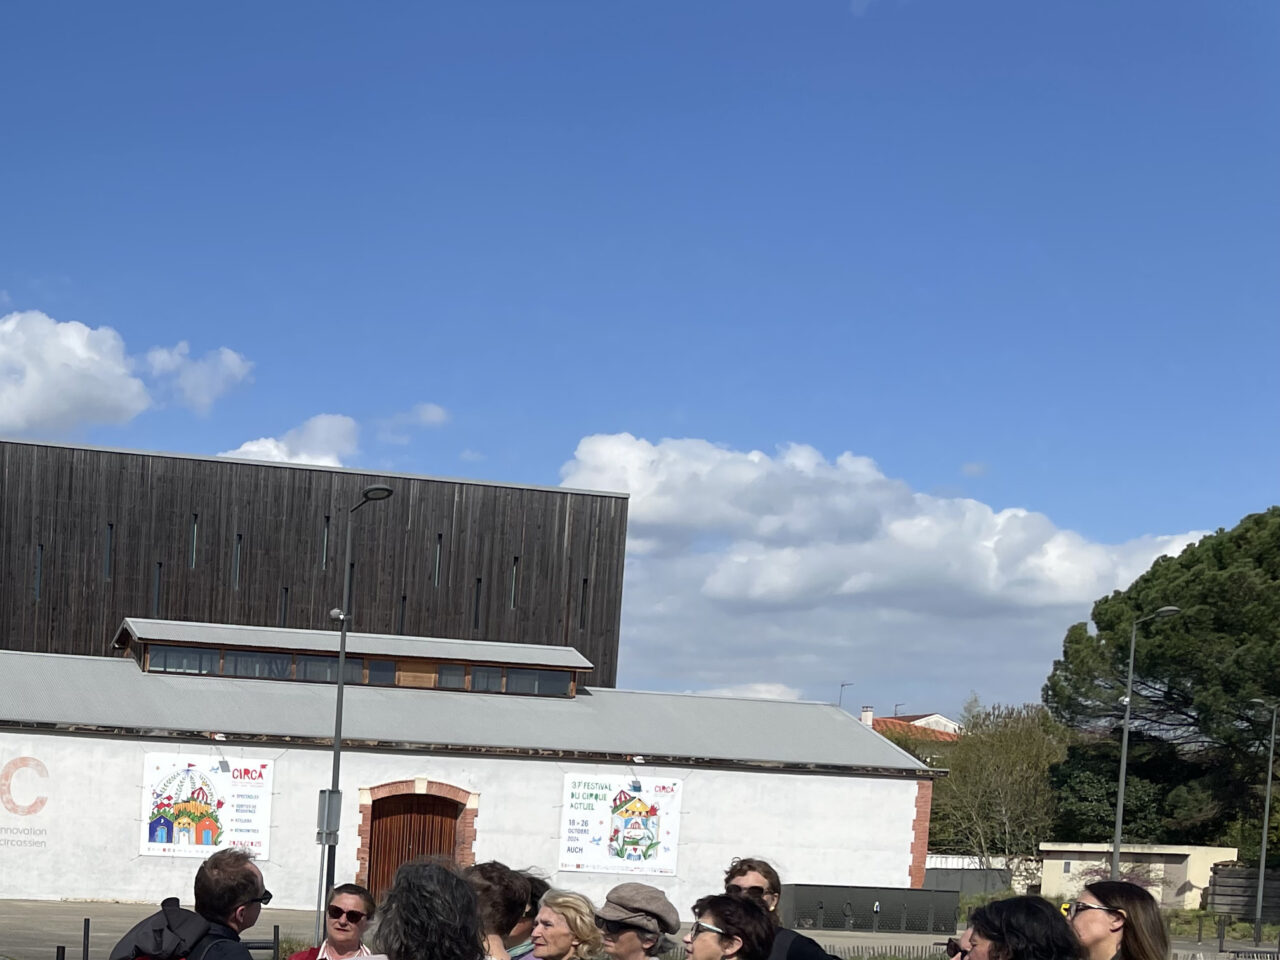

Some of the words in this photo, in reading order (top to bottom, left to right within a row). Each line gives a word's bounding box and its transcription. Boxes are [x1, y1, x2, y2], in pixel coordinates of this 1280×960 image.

[232, 767, 264, 781] CIRCA
[583, 781, 612, 791] FESTIVAL
[570, 792, 580, 800] DU
[582, 792, 608, 803] CIRQUE
[570, 803, 595, 811] ACTUEL
[566, 846, 584, 854] AUCH
